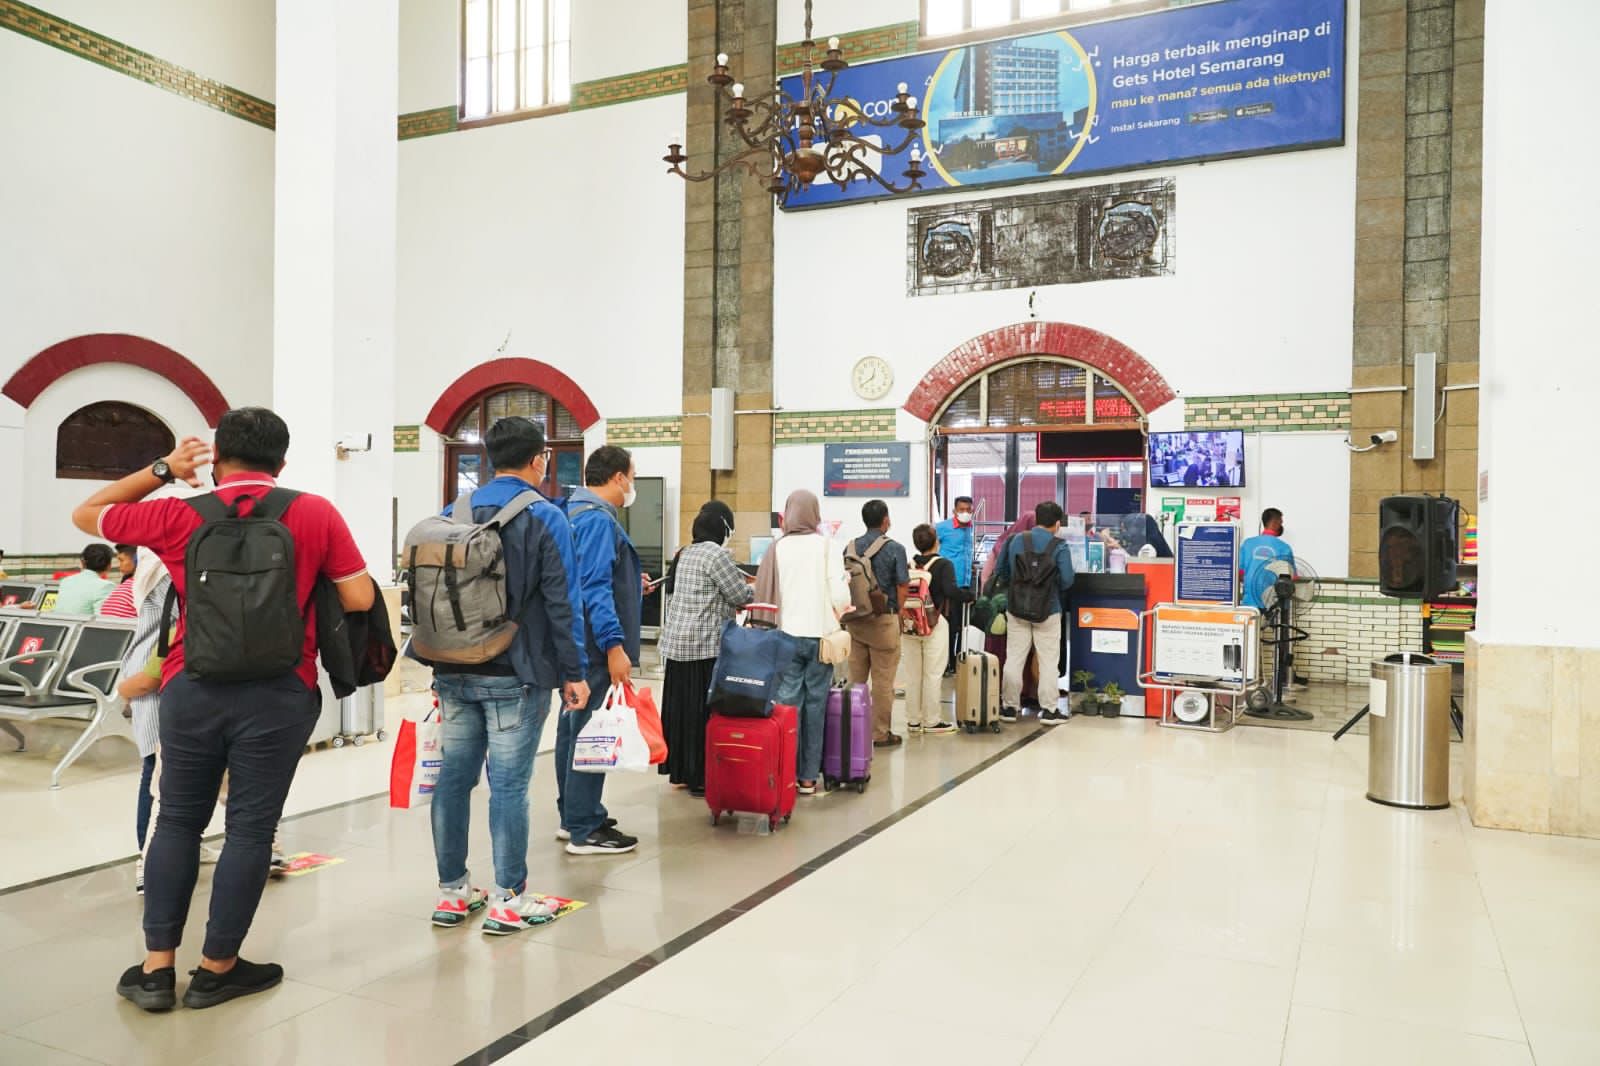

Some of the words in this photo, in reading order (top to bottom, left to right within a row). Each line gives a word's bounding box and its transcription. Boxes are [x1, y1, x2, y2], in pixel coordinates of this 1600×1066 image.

[1112, 51, 1160, 68] Harga
[1165, 40, 1220, 61] terbaik
[1225, 28, 1310, 51] menginap
[1314, 21, 1331, 37] di
[1111, 96, 1137, 109] mau
[1140, 94, 1154, 105] ke
[1158, 86, 1197, 102] mana?
[1199, 82, 1242, 97] semua
[1245, 77, 1270, 90] ada
[1273, 68, 1331, 86] tiketnya!
[1112, 73, 1148, 89] Gets
[1152, 65, 1195, 83] Hotel
[1199, 52, 1284, 75] Semarang
[1136, 116, 1181, 130] Sekarang
